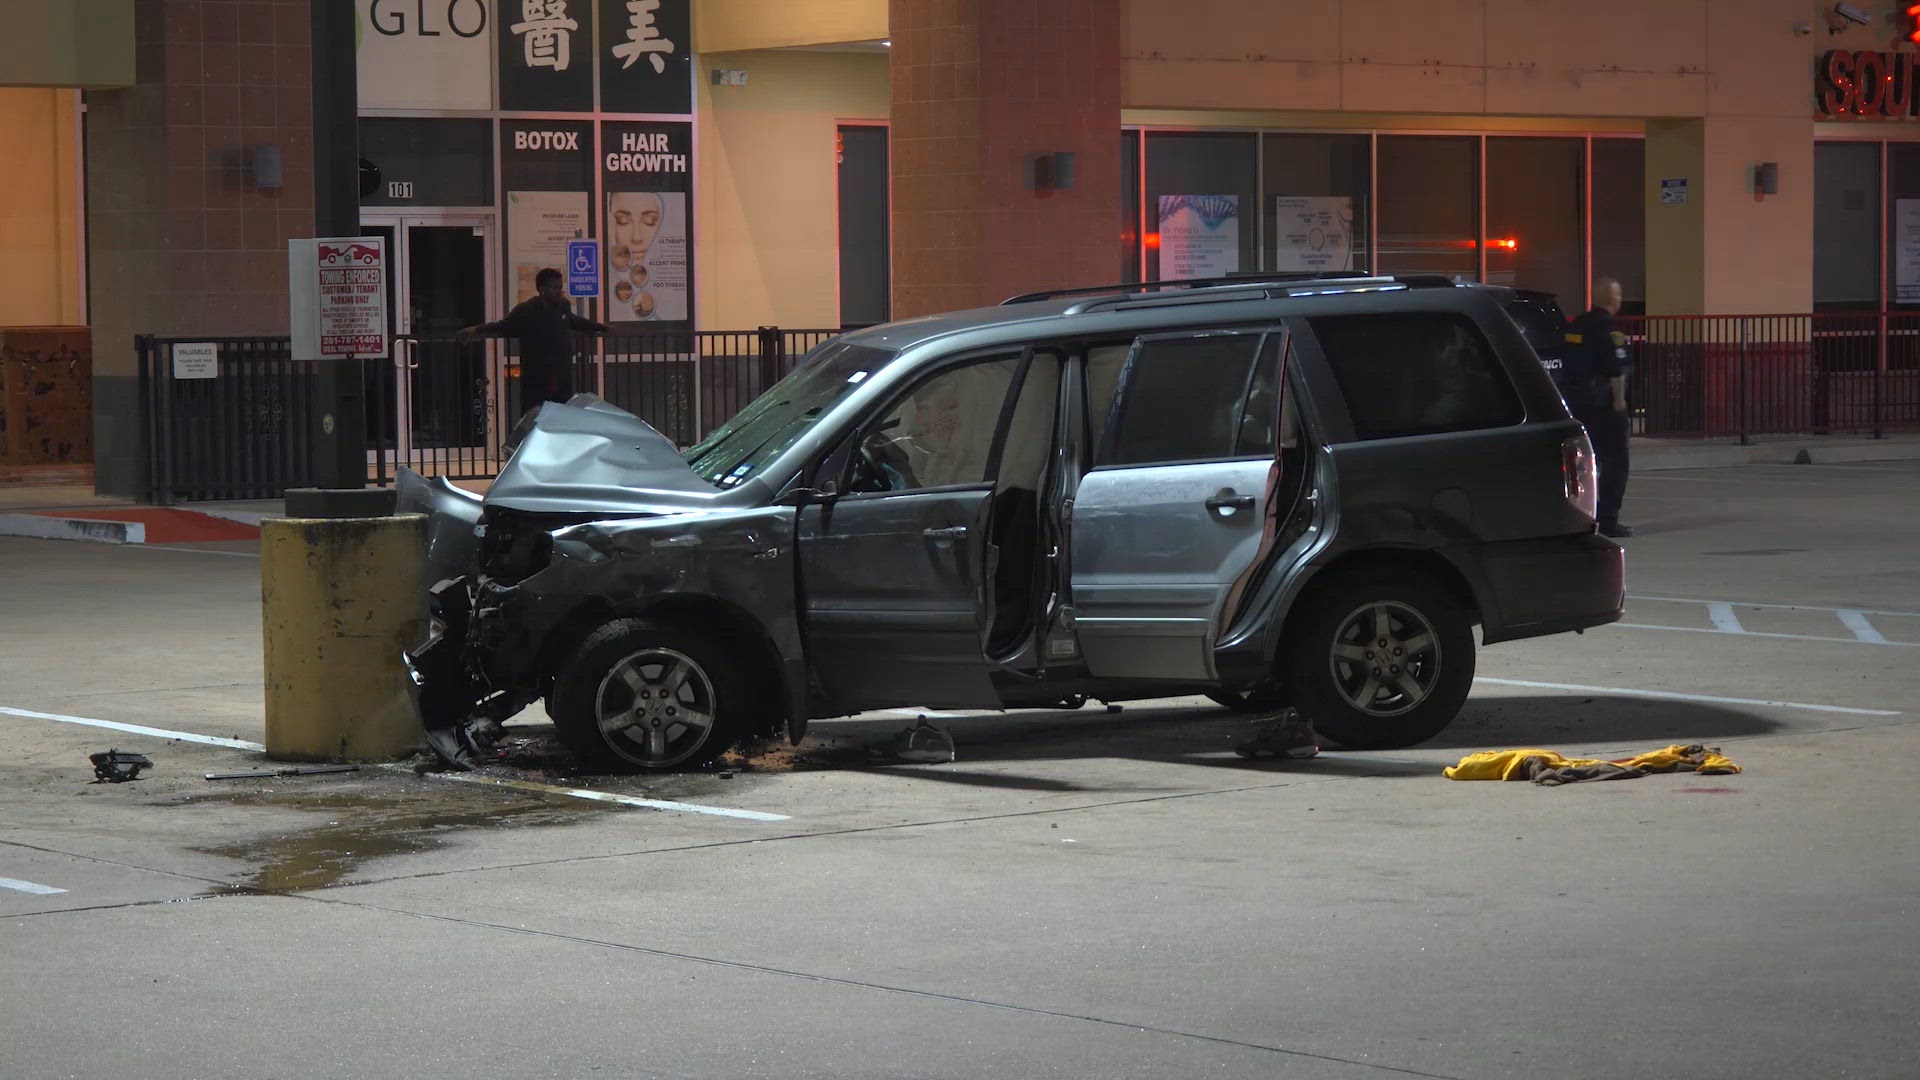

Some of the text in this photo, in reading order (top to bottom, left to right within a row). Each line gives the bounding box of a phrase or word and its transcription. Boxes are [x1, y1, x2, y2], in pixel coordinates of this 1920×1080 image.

[370, 0, 486, 38] GLO
[514, 130, 579, 150] BOTOX
[622, 133, 670, 153] HAIR
[606, 153, 686, 173] GROWTH
[390, 182, 413, 198] 101
[321, 269, 380, 284] TOWING ENFORCED
[356, 285, 378, 293] TENANT
[331, 295, 370, 305] PARKING ONLY
[323, 335, 380, 344] 281-787-1401
